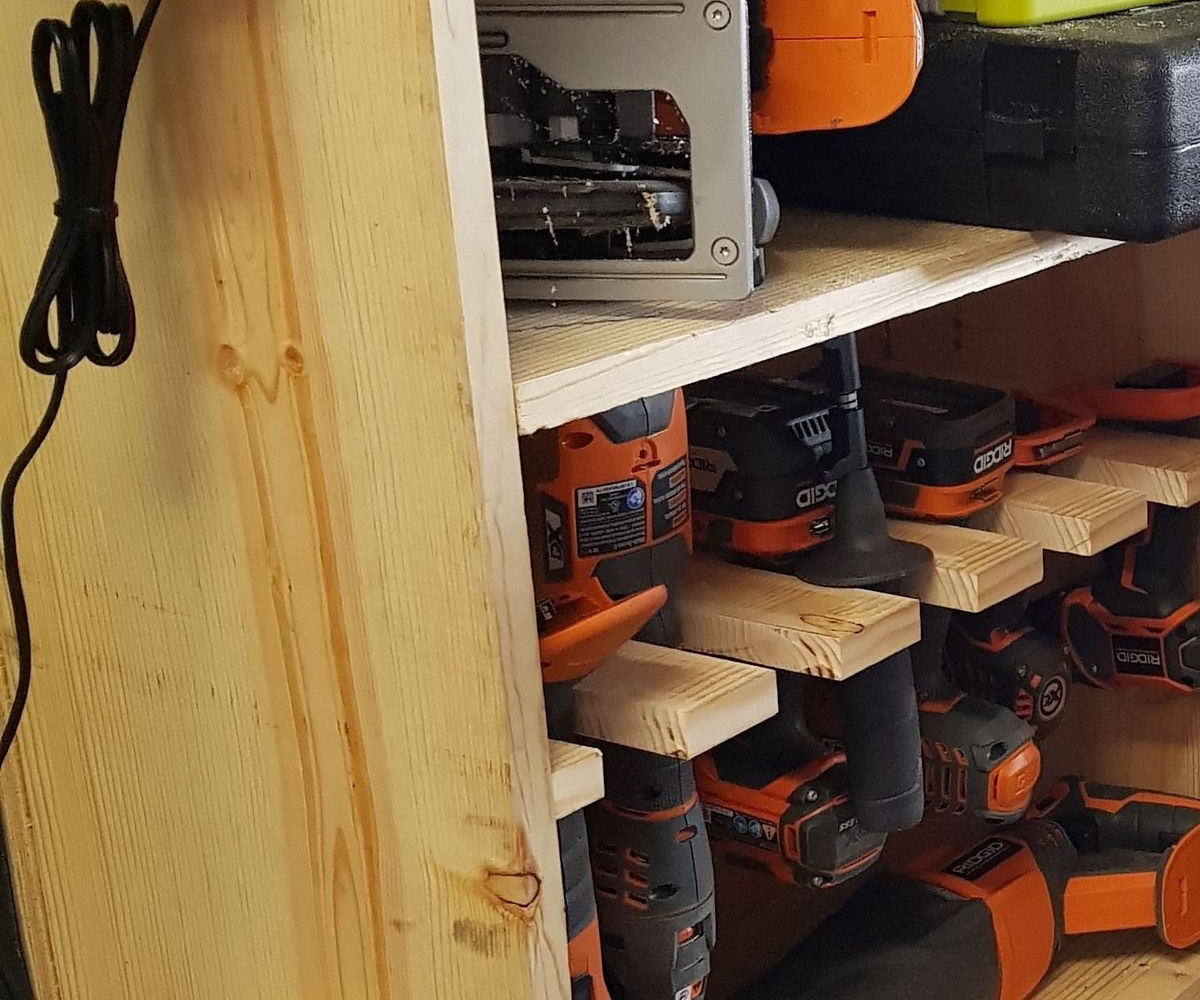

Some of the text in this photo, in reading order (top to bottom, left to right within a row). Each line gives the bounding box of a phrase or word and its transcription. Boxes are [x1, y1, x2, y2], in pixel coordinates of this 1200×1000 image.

[973, 438, 1012, 474] RIDGID
[1116, 650, 1161, 666] RIDGID
[951, 841, 1004, 874] RIDGID
